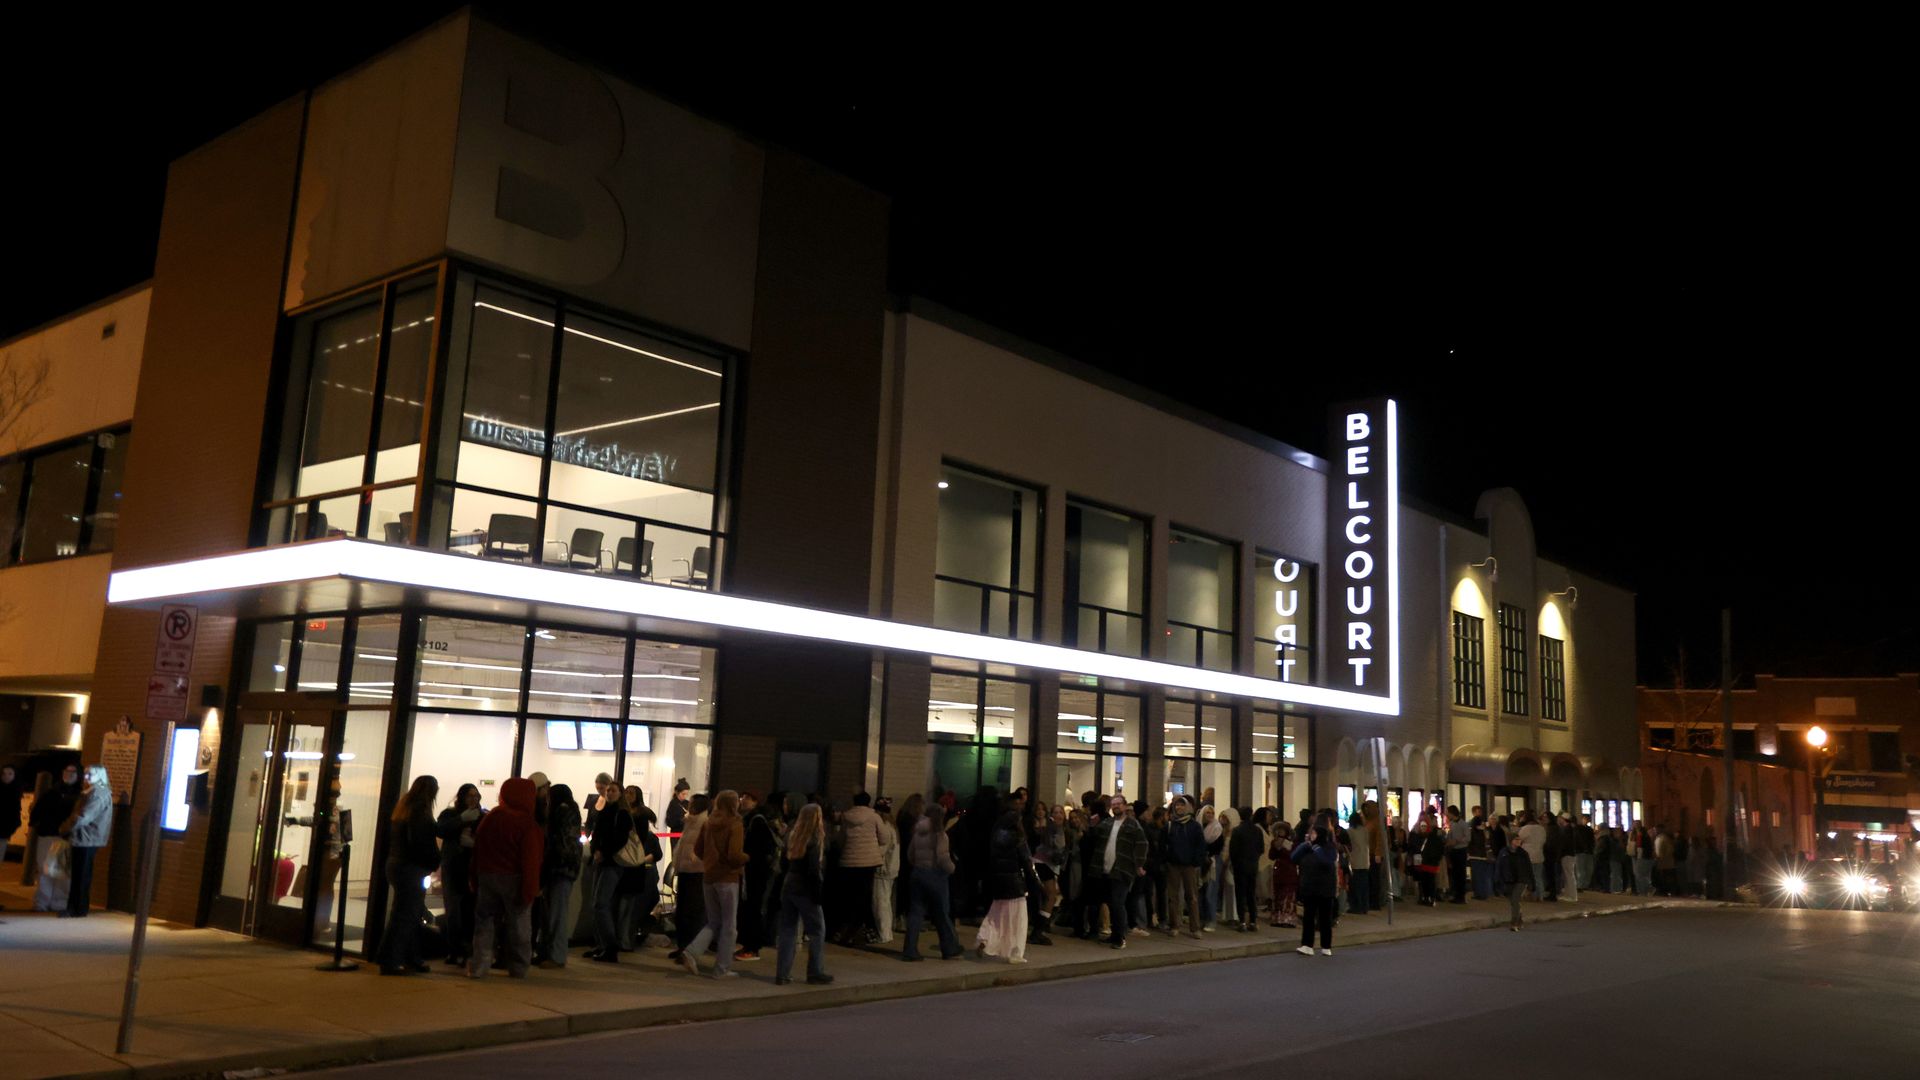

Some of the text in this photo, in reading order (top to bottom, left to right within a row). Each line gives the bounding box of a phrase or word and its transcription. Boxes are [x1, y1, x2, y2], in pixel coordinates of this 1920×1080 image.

[450, 28, 628, 286] B
[422, 640, 449, 652] 2102
[1345, 411, 1374, 687] BELCOURT
